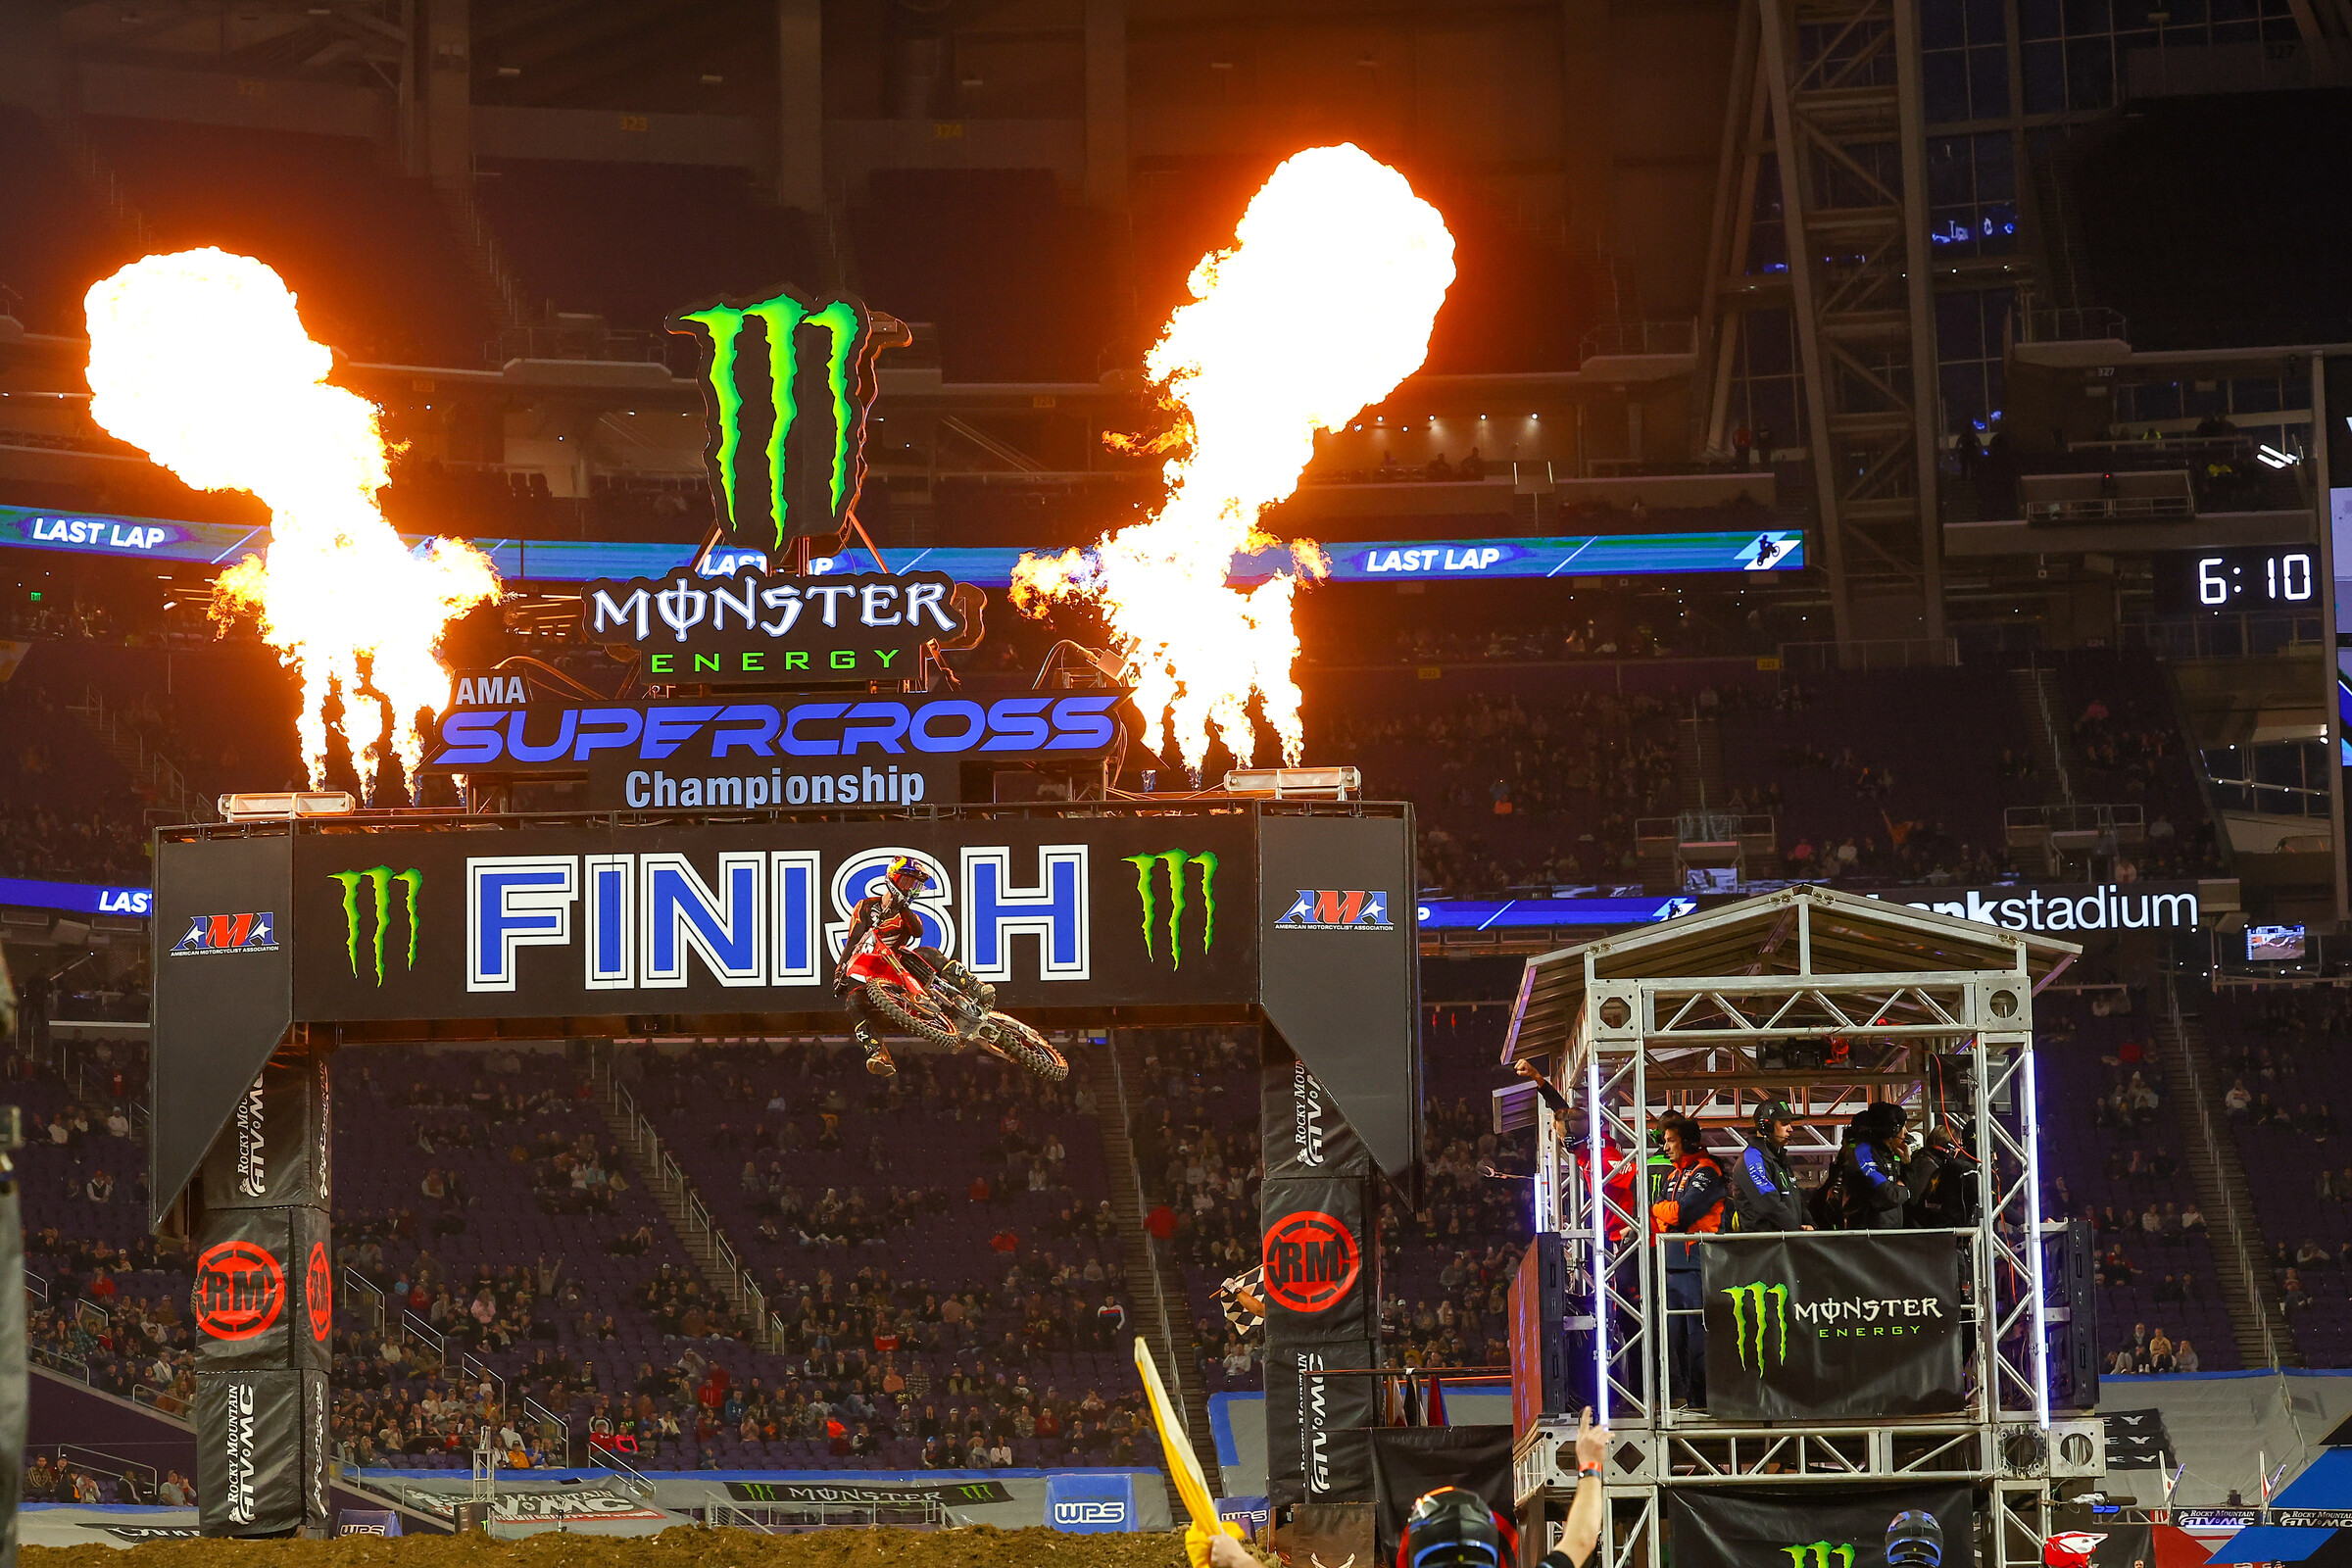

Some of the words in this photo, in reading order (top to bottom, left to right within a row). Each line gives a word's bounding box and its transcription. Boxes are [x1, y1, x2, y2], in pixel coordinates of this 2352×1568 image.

[2096, 367, 2116, 377] 327
[32, 518, 105, 545] LAST
[110, 523, 166, 549] LAP
[1366, 548, 1442, 572] LAST
[1444, 548, 1499, 570] LAP
[592, 576, 957, 642] MONSTER
[651, 649, 900, 673] ENERGY
[455, 676, 526, 705] AMA
[432, 697, 1120, 764] SUPERCROSS
[625, 765, 926, 809] Championship
[99, 891, 153, 913] LAS
[1274, 890, 1394, 924] AMA
[170, 911, 279, 951] AMA
[466, 843, 1090, 993] FINISH
[200, 947, 242, 956] MOTORCYCLIST
[242, 945, 279, 954] ASSOCIATION
[1296, 1101, 1306, 1146] ROCKY
[238, 1132, 250, 1175] ROCKY
[1794, 1296, 1943, 1324] MONSTER
[1819, 1325, 1921, 1338] ENERGY
[226, 1384, 238, 1458] MOUNTAIN
[227, 1459, 238, 1504] ROCKY
[788, 1487, 944, 1501] MONSTER
[1054, 1501, 1125, 1524] WPS
